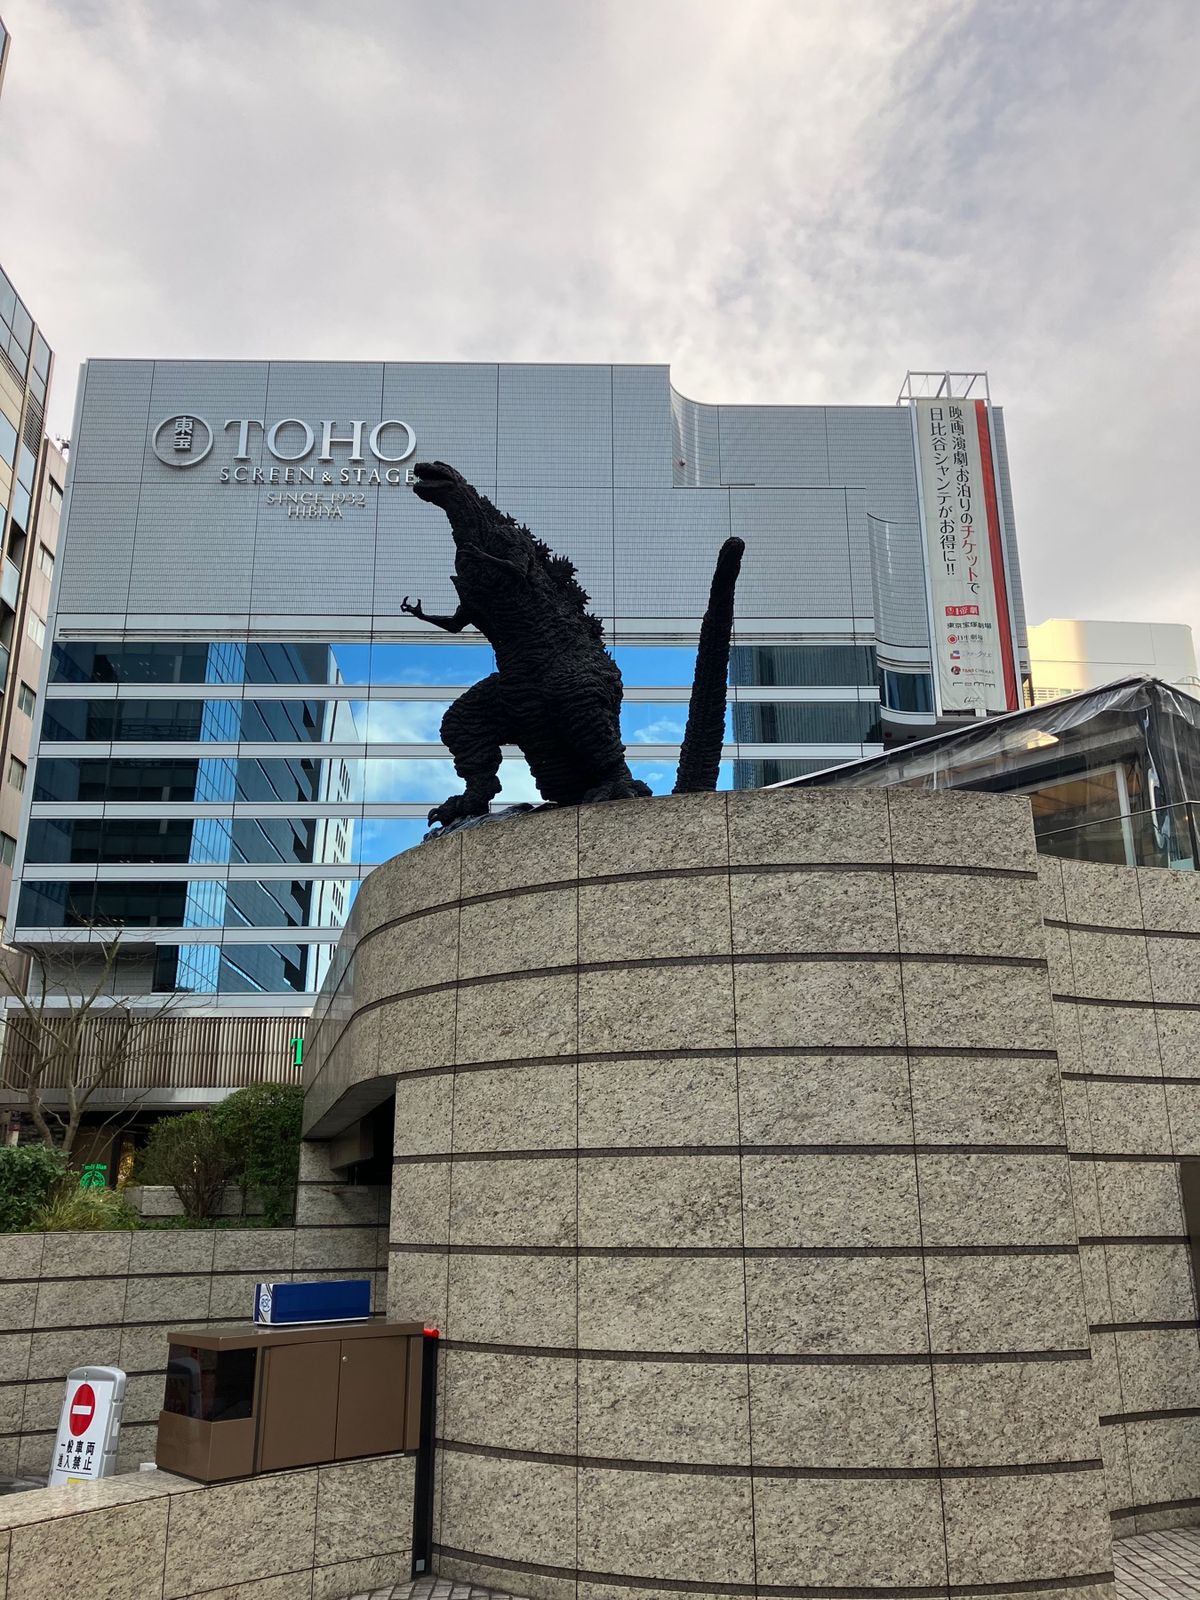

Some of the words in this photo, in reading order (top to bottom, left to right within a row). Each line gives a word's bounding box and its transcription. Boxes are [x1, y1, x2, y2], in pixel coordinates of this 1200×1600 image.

[173, 417, 194, 452] 東宝
[224, 418, 417, 462] TOHO
[220, 467, 315, 482] SCREEN
[322, 471, 332, 483] &
[339, 468, 416, 485] STAGE
[266, 492, 323, 506] SINCE
[331, 492, 366, 507] 1932
[288, 505, 343, 518] HIBIYA
[60, 1440, 96, 1456] 一般車両
[57, 1453, 92, 1470] 進入禁止
